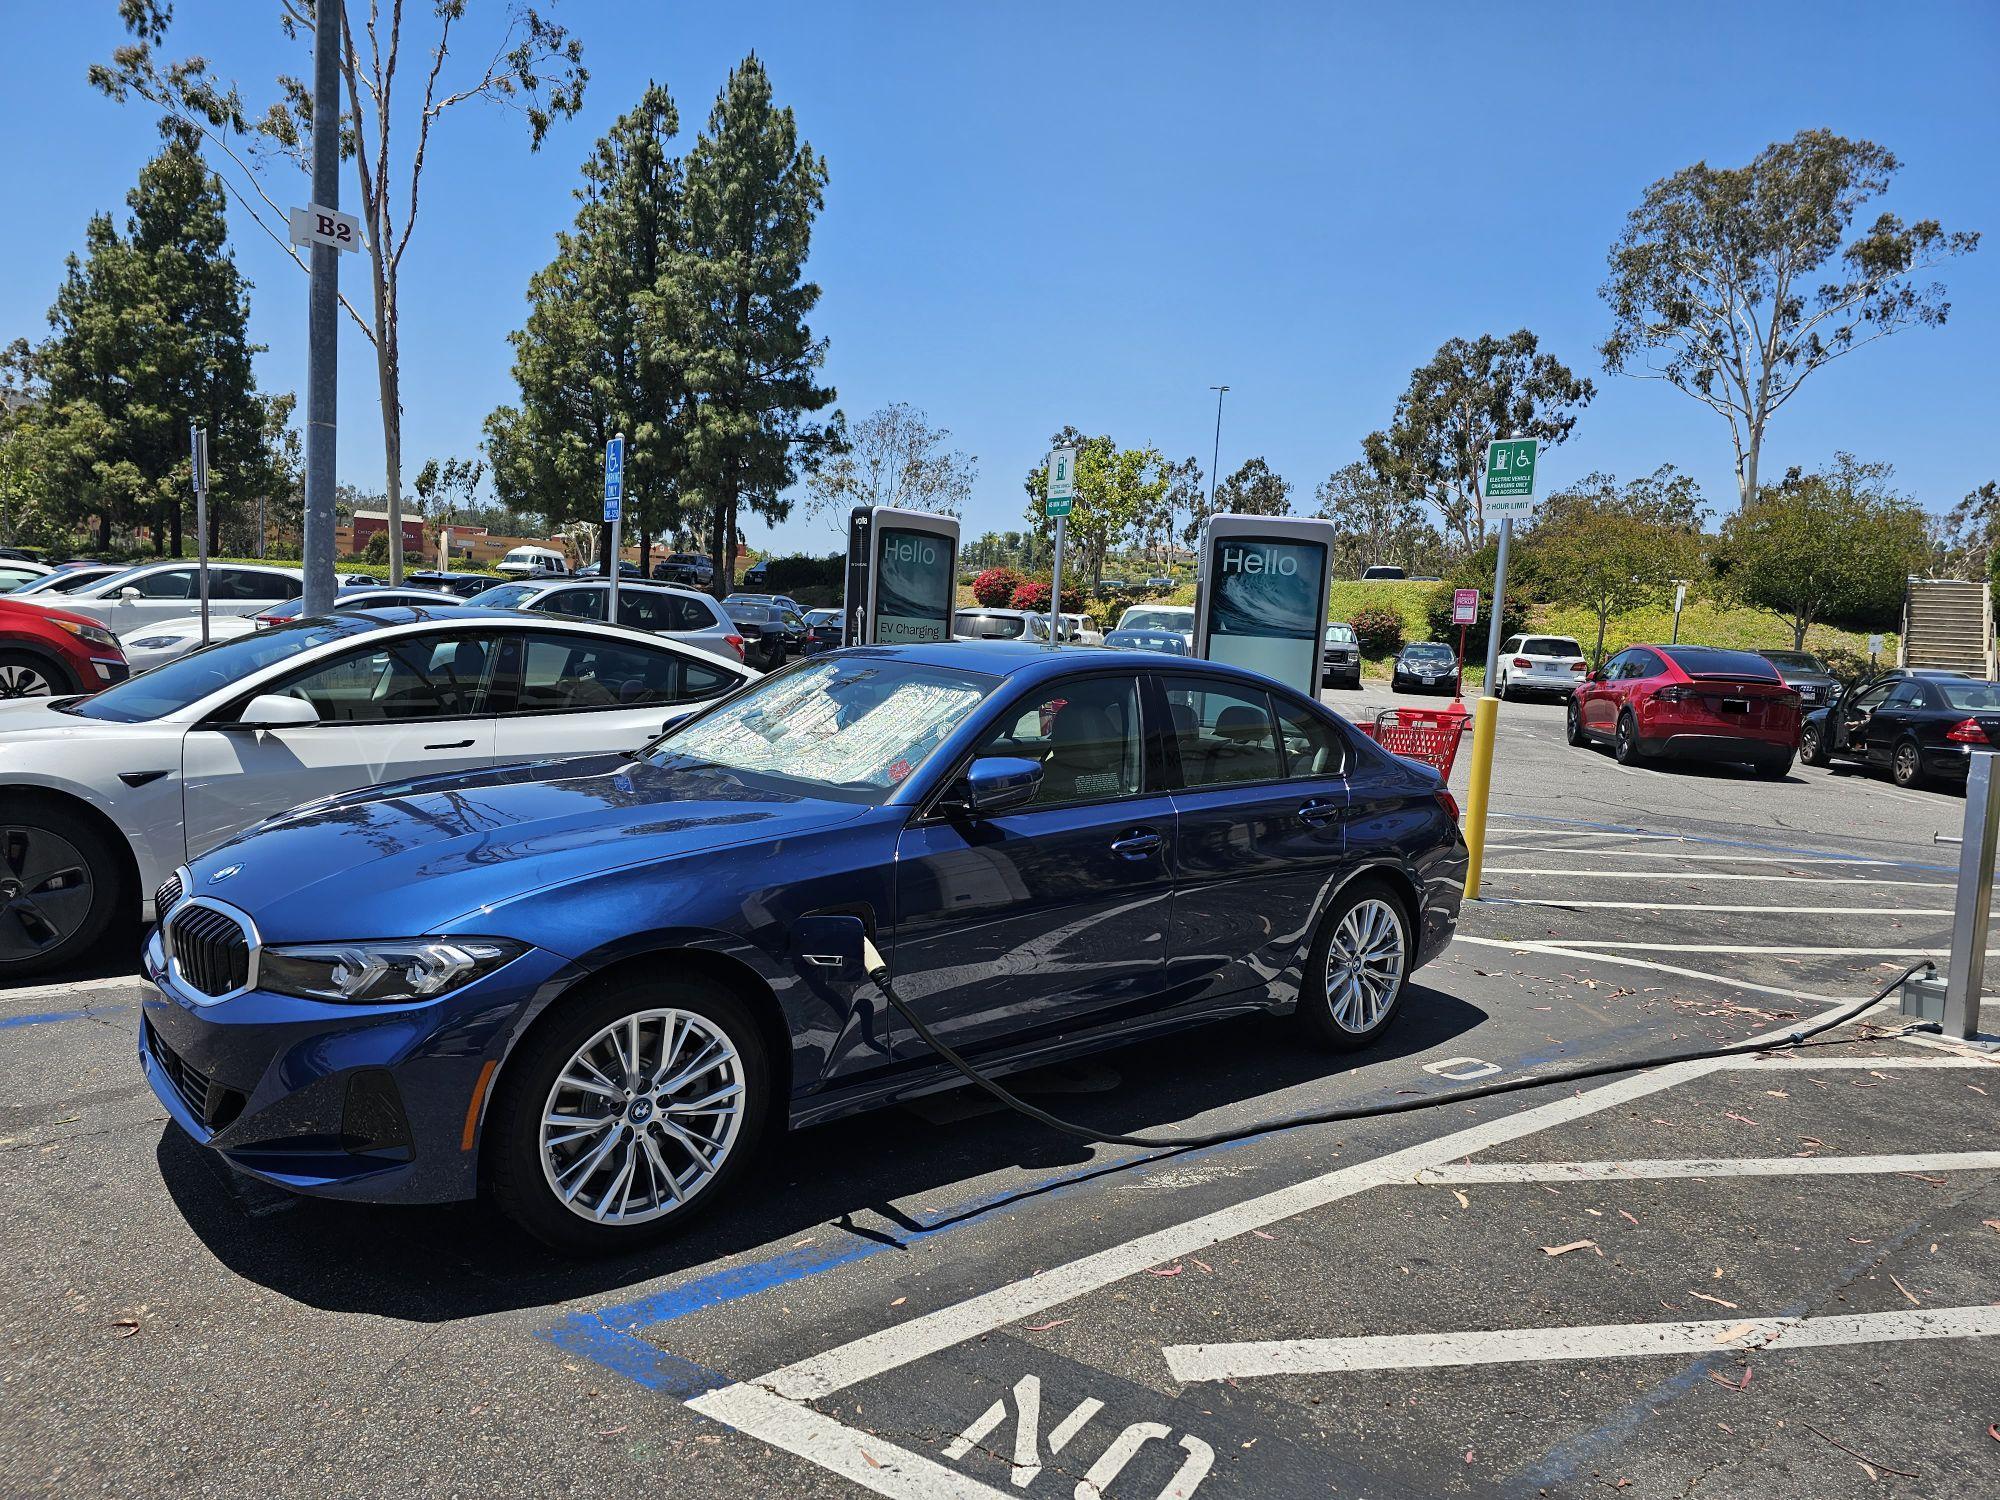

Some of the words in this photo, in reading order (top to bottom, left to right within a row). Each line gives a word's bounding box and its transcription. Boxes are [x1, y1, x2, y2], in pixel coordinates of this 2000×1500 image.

[316, 213, 351, 242] B2
[885, 538, 936, 564] Hello
[1223, 549, 1298, 576] Hello
[881, 622, 894, 633] EV
[896, 623, 940, 640] Charging
[941, 1373, 1215, 1500] NO
